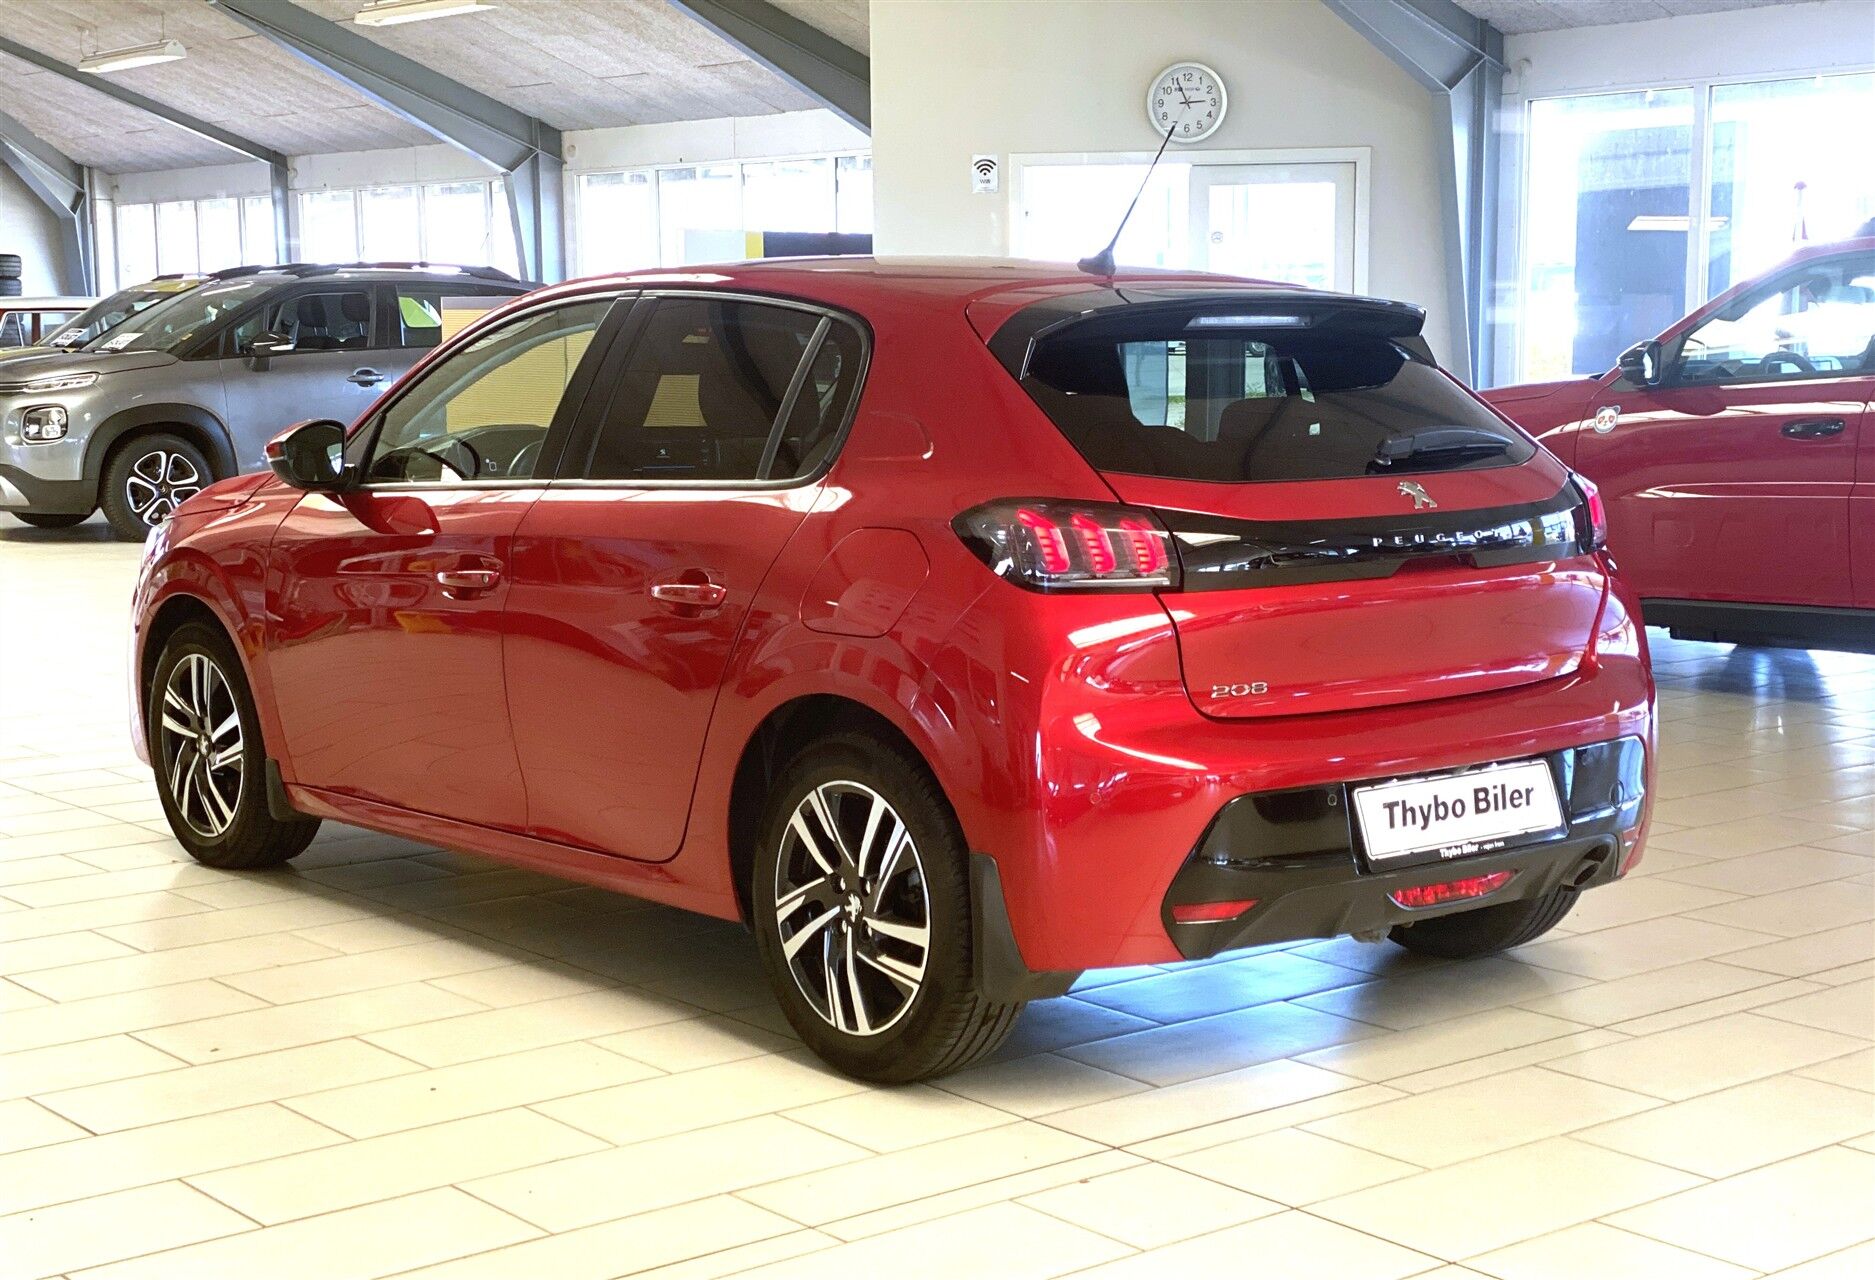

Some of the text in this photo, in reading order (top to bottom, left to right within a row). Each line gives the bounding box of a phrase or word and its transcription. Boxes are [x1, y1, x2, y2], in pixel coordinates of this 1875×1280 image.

[1183, 73, 1193, 82] 12
[1199, 76, 1203, 85] 1
[1162, 86, 1172, 95] 10
[1206, 85, 1213, 94] 2
[1158, 98, 1164, 108] 9
[1210, 98, 1217, 107] 3
[1162, 111, 1168, 121] 8
[1206, 110, 1213, 119] 4
[1183, 123, 1190, 133] 6
[1196, 120, 1203, 129] 5
[1372, 528, 1502, 547] PEUGEOT
[1211, 681, 1268, 699] 208
[1383, 783, 1534, 831] Thybo Biler
[1440, 847, 1461, 858] Thybo
[1462, 843, 1479, 854] Biler
